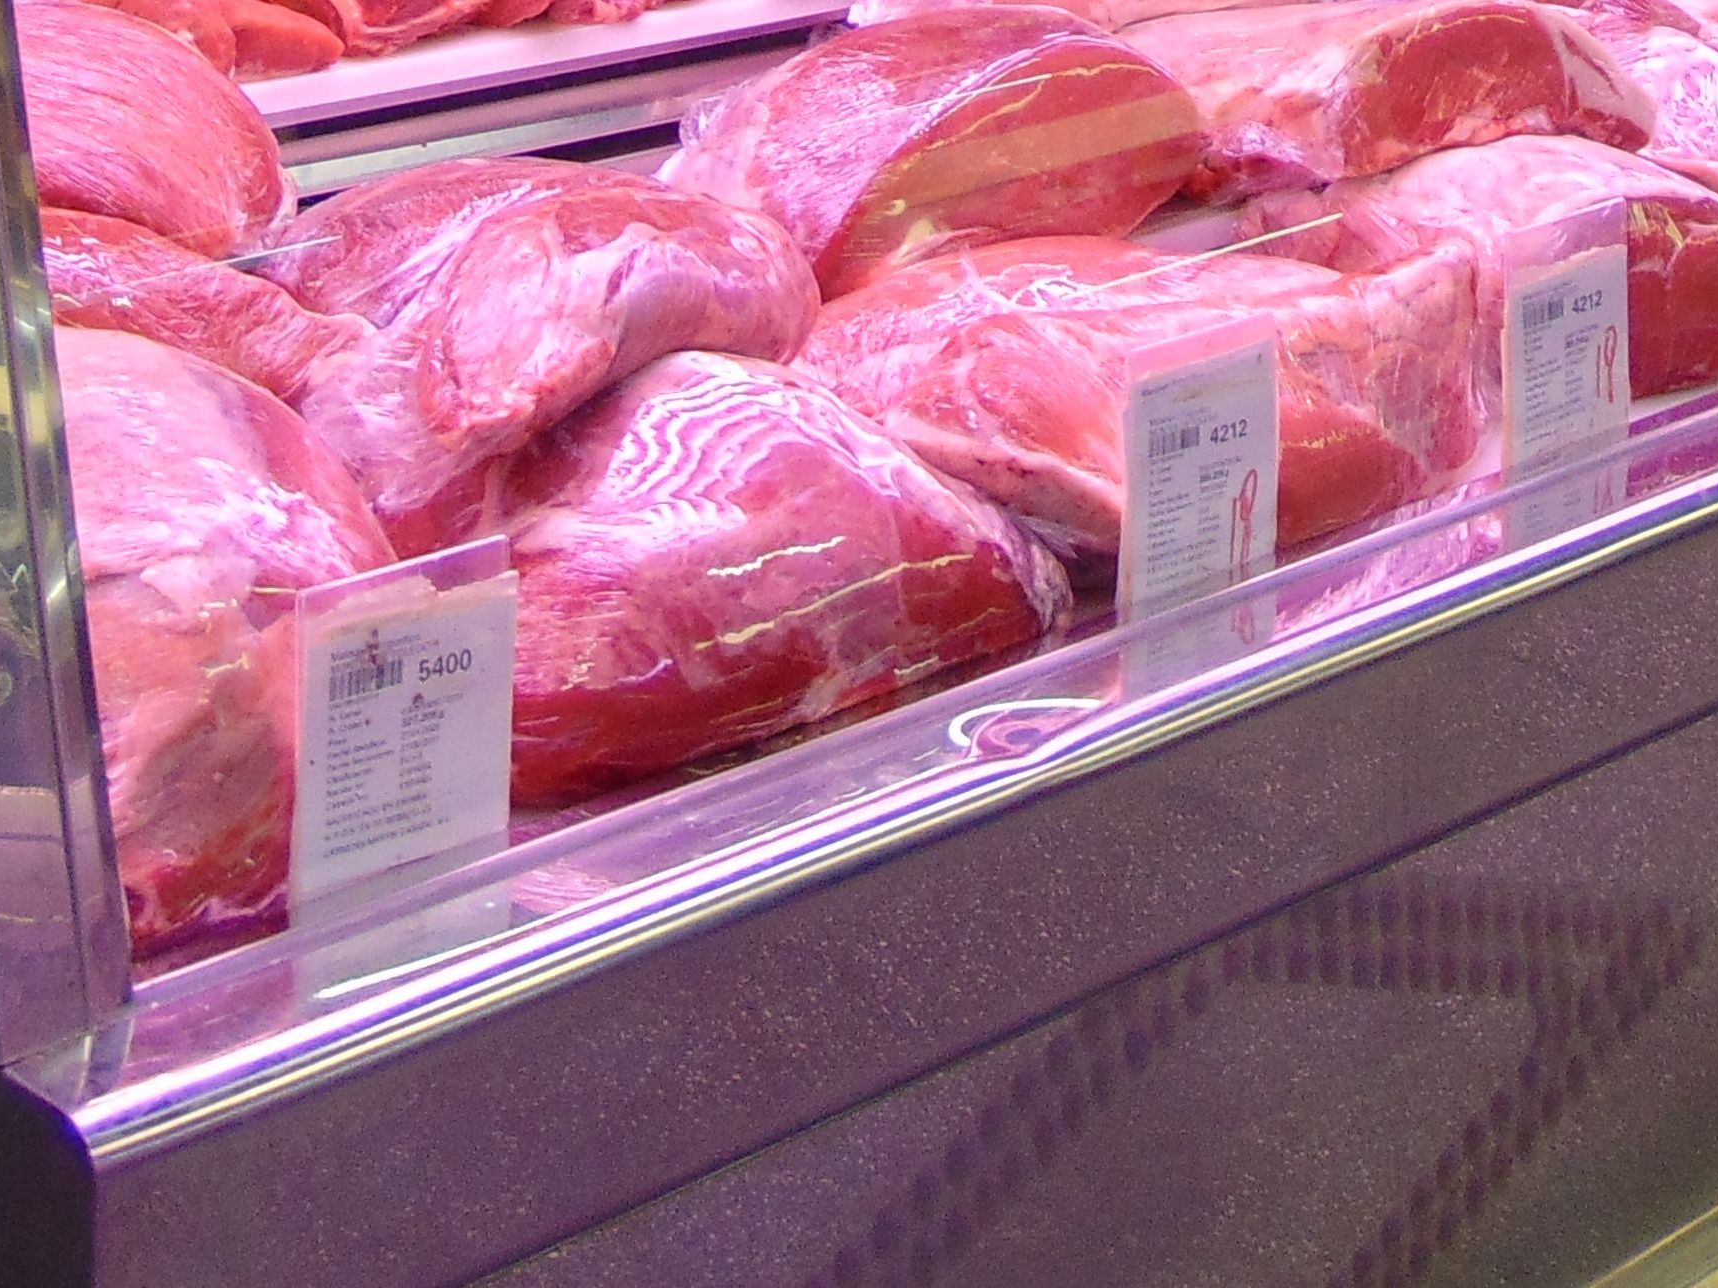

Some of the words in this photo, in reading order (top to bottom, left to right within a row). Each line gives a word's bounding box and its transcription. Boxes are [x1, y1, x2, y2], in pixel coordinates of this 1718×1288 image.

[1571, 289, 1604, 314] 4212
[1209, 418, 1249, 445] 4212
[418, 648, 474, 683] 5400
